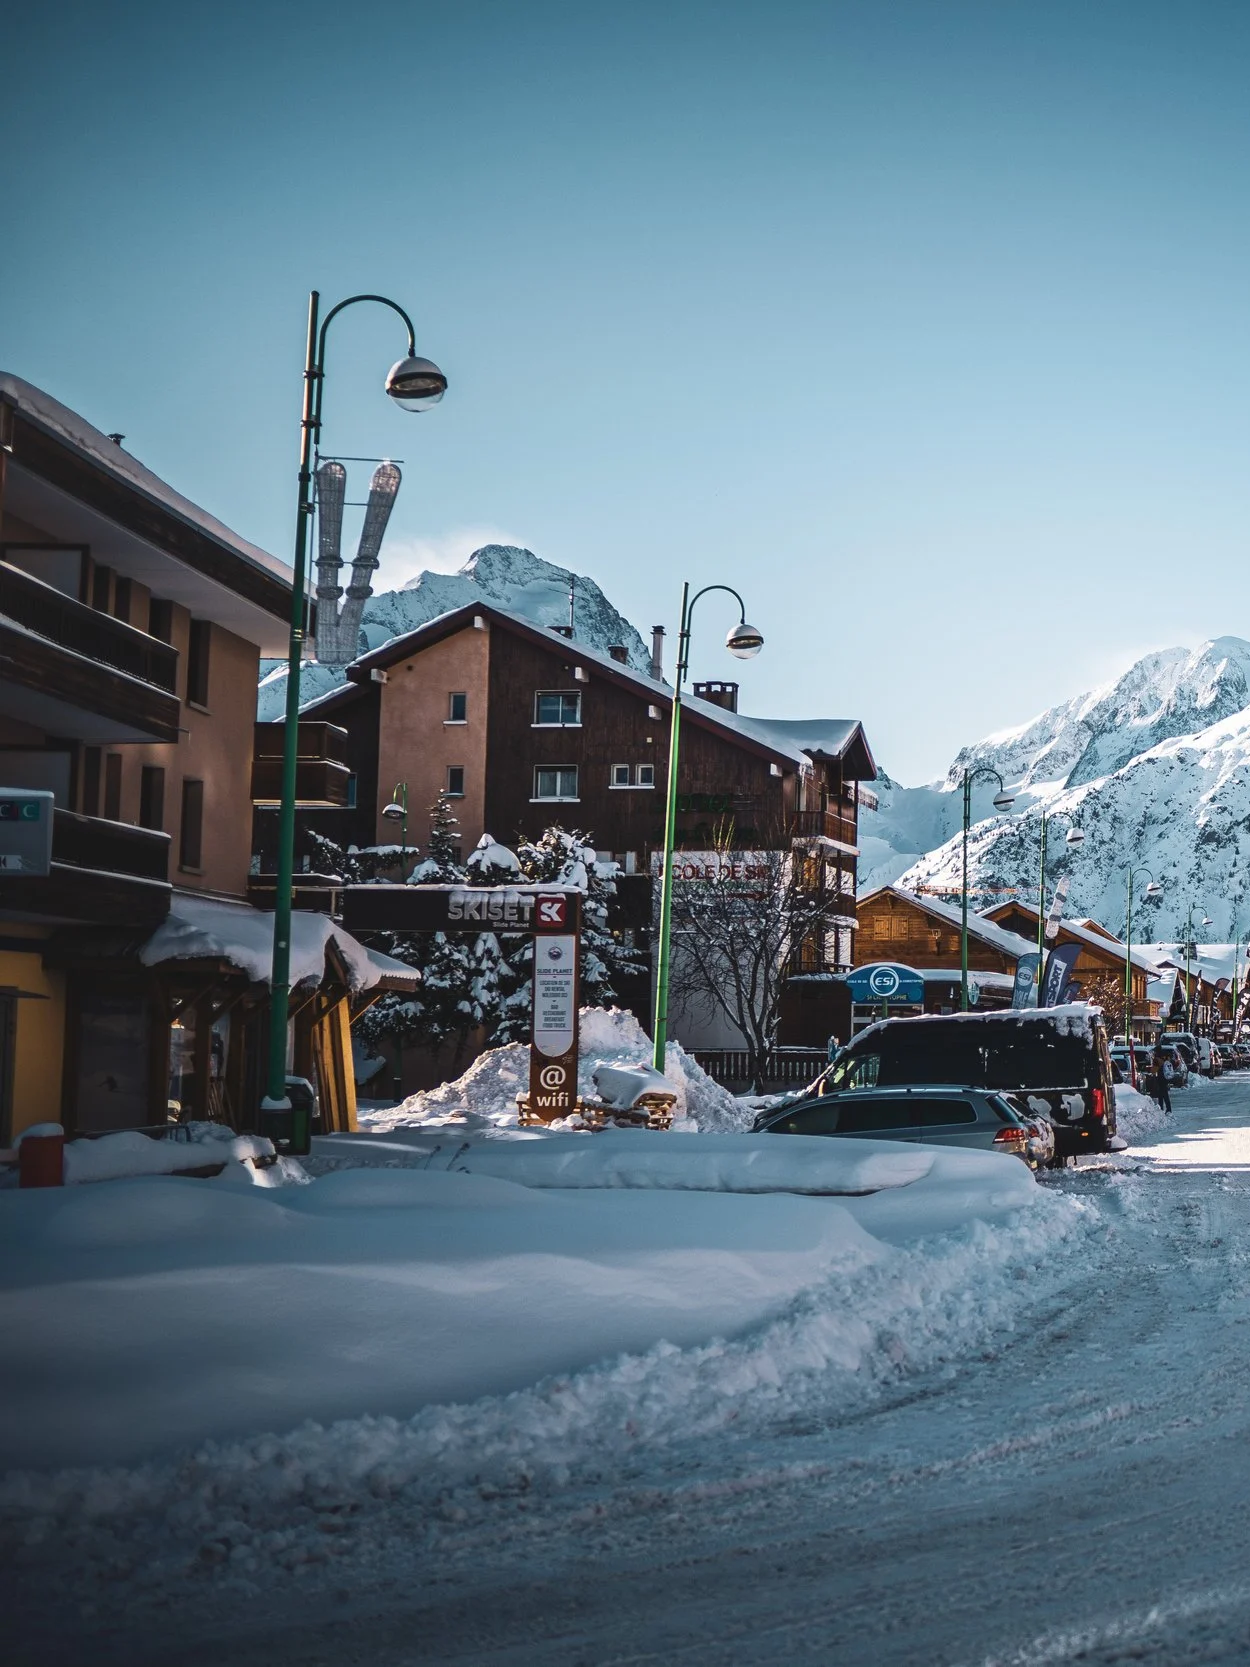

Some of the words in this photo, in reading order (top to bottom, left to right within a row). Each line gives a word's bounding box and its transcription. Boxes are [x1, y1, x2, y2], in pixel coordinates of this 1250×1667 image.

[448, 898, 535, 921] SKISET
[540, 1065, 566, 1090] @
[536, 1091, 569, 1107] wifi
